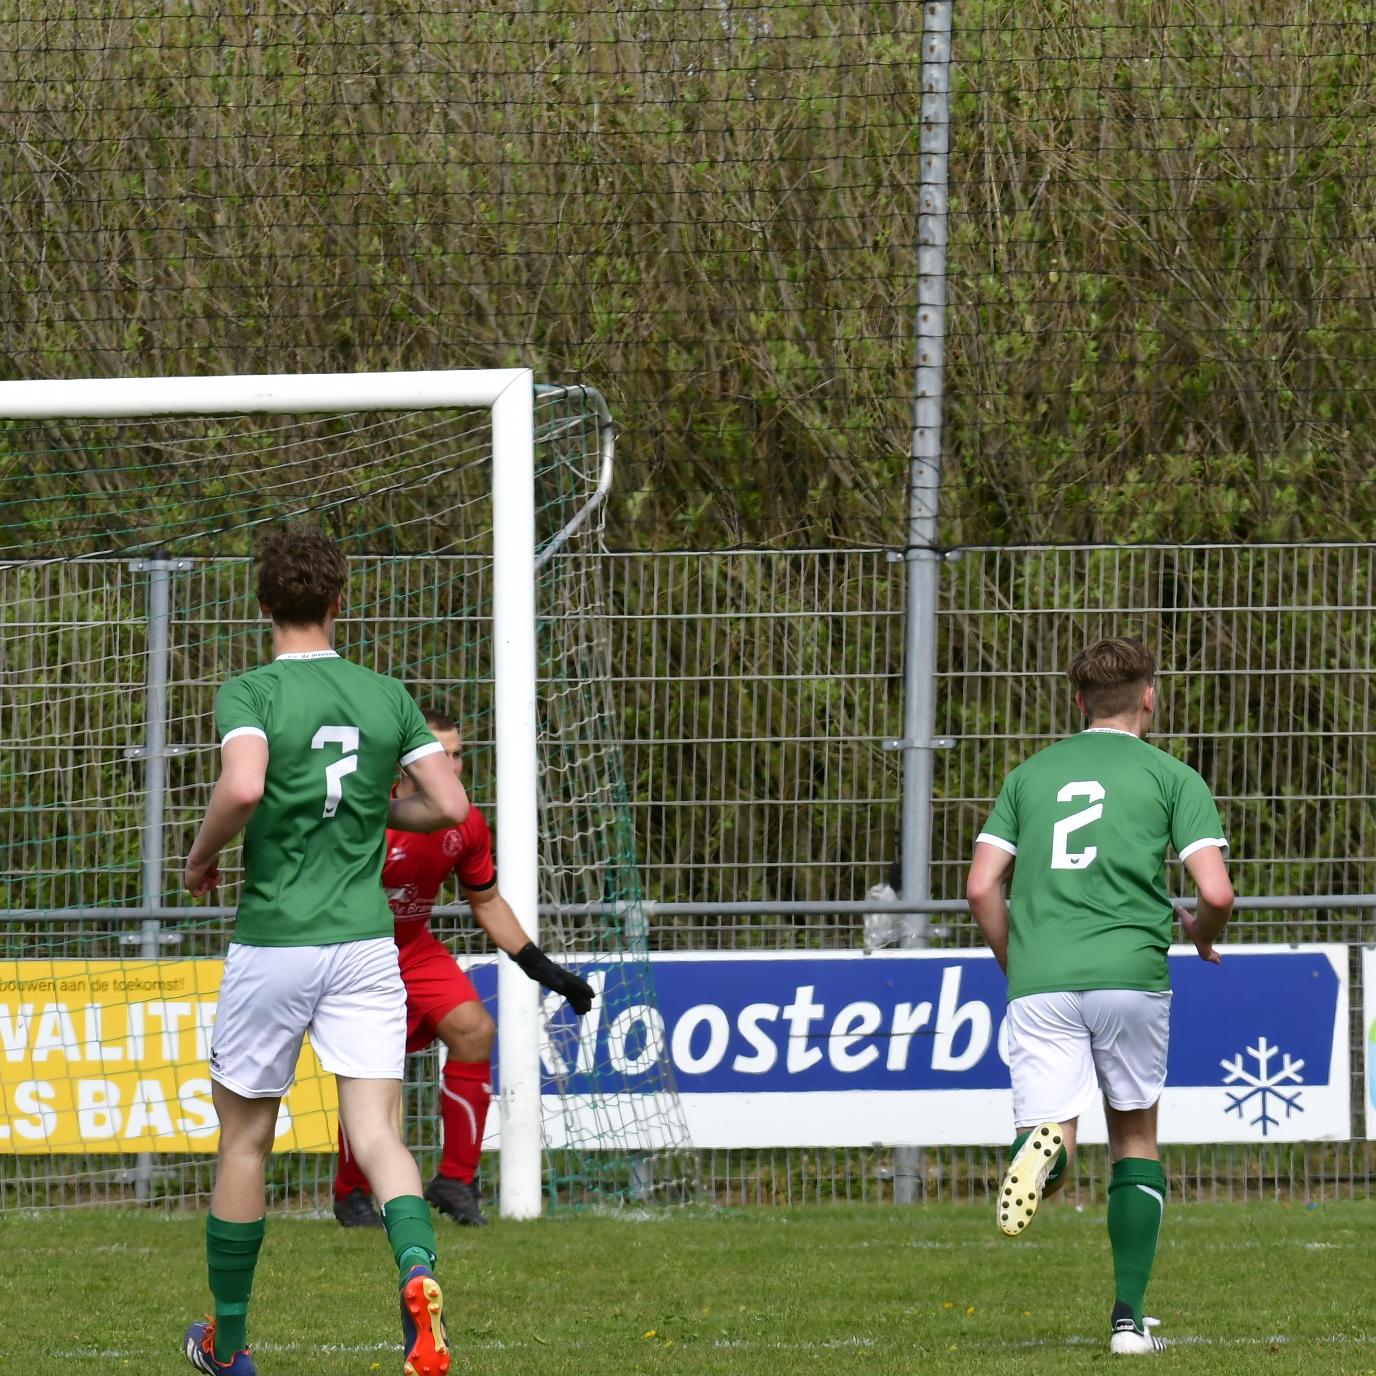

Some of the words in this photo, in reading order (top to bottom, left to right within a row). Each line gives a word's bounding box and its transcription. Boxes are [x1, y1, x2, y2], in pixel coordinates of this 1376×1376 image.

[311, 726, 360, 818] 7
[1051, 781, 1106, 870] 2
[59, 980, 87, 992] aan
[90, 978, 110, 992] de
